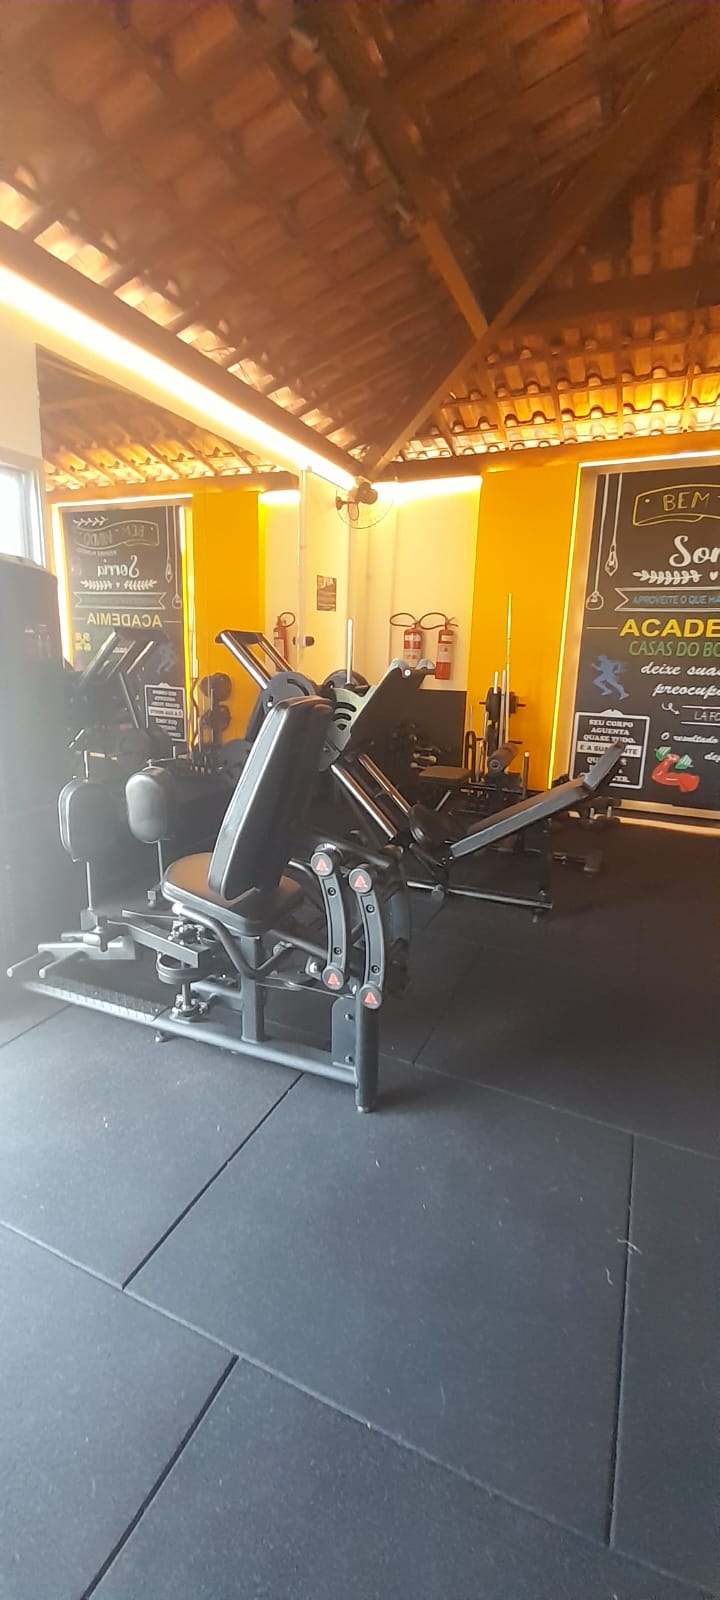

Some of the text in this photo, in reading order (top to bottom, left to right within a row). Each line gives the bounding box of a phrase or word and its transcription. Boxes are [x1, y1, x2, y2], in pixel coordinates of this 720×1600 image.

[663, 492, 710, 511] BEM
[632, 595, 679, 605] APROVEITE
[680, 595, 687, 605] O
[688, 595, 707, 605] QUE
[629, 640, 673, 656] CASAS
[676, 641, 699, 657] DO
[640, 661, 681, 675] deixe
[606, 720, 634, 728] CORPO
[591, 728, 630, 736] AGUENTA
[661, 732, 670, 740] O
[583, 734, 611, 742] QUASE
